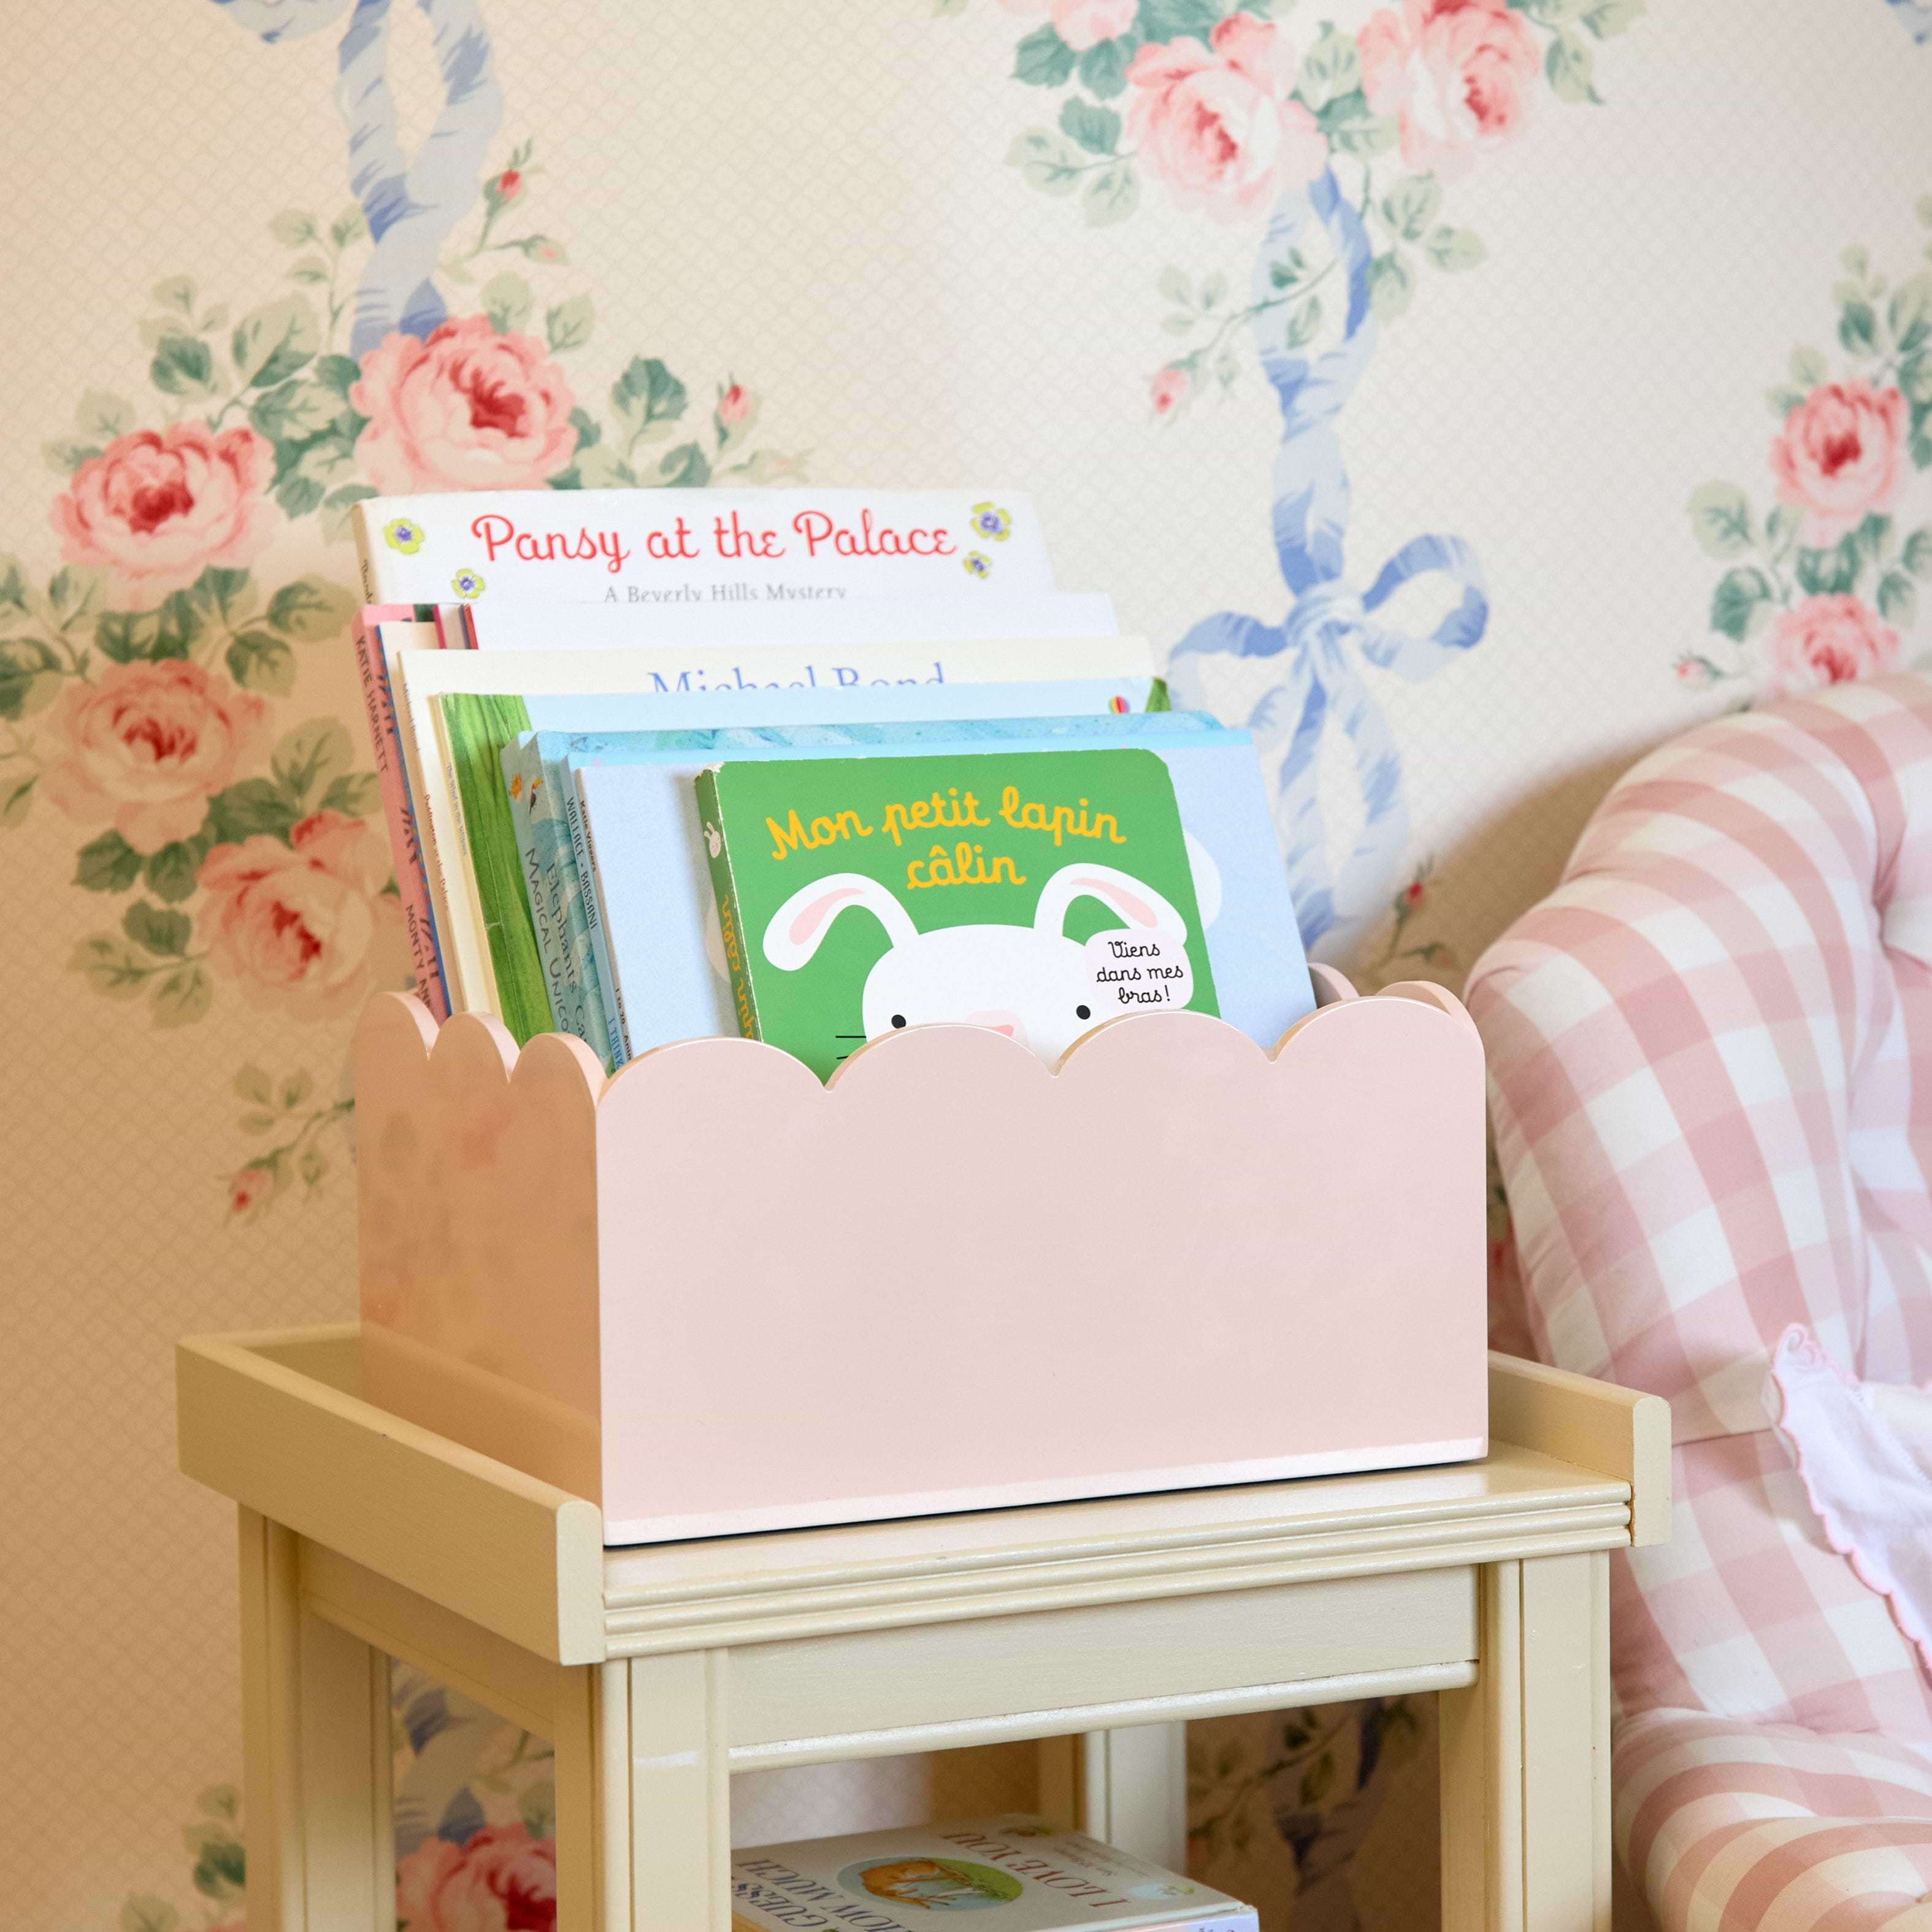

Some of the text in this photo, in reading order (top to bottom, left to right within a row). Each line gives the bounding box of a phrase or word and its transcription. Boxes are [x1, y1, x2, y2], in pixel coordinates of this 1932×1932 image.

[470, 508, 957, 573] Pansy at the Palace
[604, 583, 846, 603] A Beverly Hills Mystery
[356, 635, 388, 772] KATIE HARNETT
[765, 786, 1127, 860] Mon petit lapin
[566, 797, 597, 930] WALLACE BASSANI
[907, 841, 1027, 889] câlin
[405, 903, 424, 970] MONTY
[525, 848, 570, 1033] MAGICAL UNICO
[546, 863, 587, 1043] Elephants Ca
[1108, 940, 1160, 958] Viens
[1096, 965, 1184, 983] dans mes
[1118, 984, 1171, 1004] bras!
[610, 1027, 626, 1071] THINK
[940, 1833, 1021, 1861] YOU
[735, 1859, 844, 1902] MUCH
[1005, 1859, 1111, 1898] LOVE
[735, 1882, 828, 1927] GUESS
[1089, 1898, 1129, 1908] I
